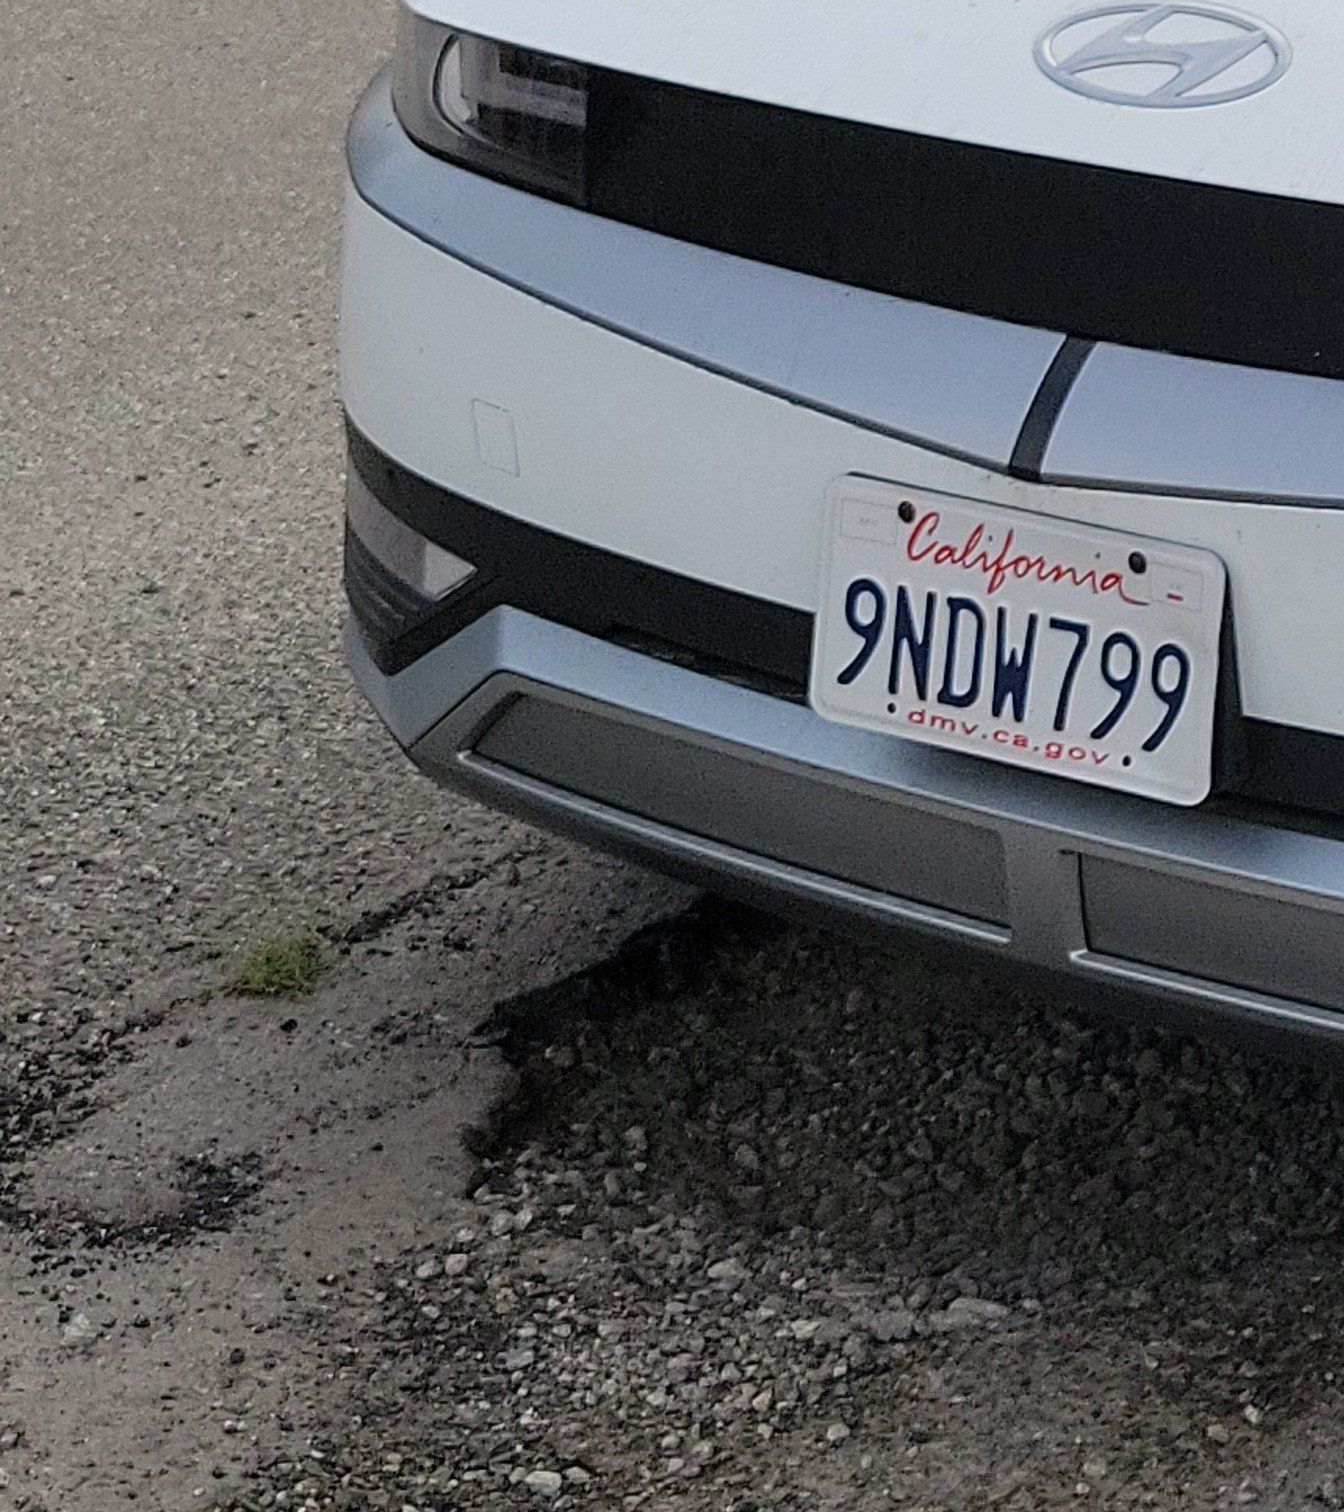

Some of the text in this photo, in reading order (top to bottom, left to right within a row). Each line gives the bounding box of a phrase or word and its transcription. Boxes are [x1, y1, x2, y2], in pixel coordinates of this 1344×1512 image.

[907, 511, 1151, 606] California
[836, 577, 1192, 753] 9NDW799
[907, 708, 1111, 765] dmv.ca.gov
